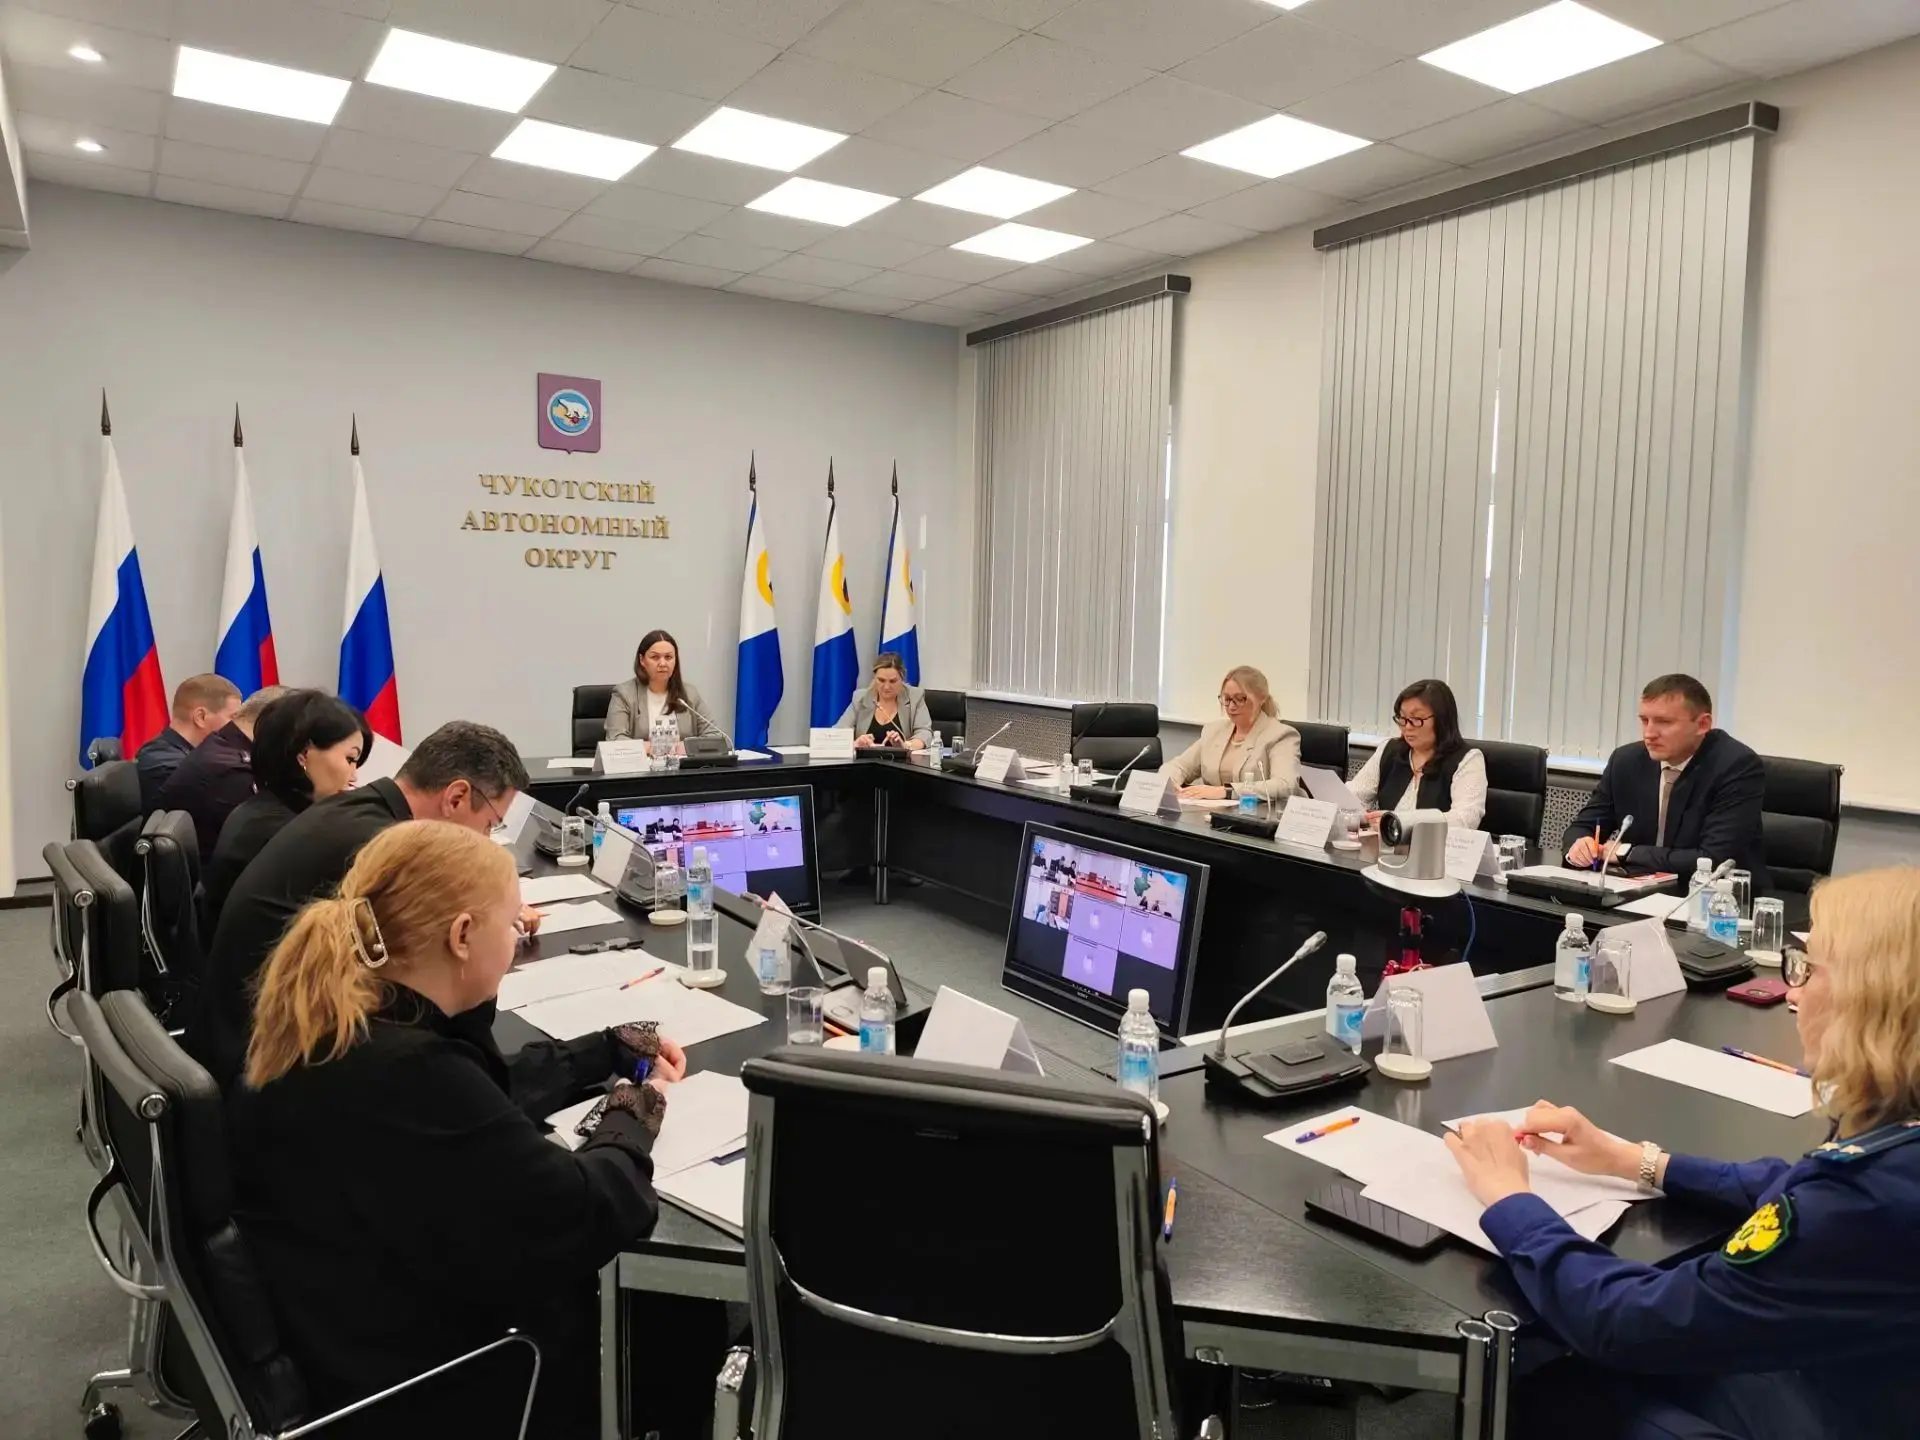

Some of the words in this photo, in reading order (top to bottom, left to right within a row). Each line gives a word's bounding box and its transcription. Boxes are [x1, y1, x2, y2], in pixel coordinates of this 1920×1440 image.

[479, 475, 656, 504] ЧУКОТСКИЙ
[460, 510, 670, 539] АВТОНОМНЫЙ
[524, 547, 617, 570] ОКРУГ
